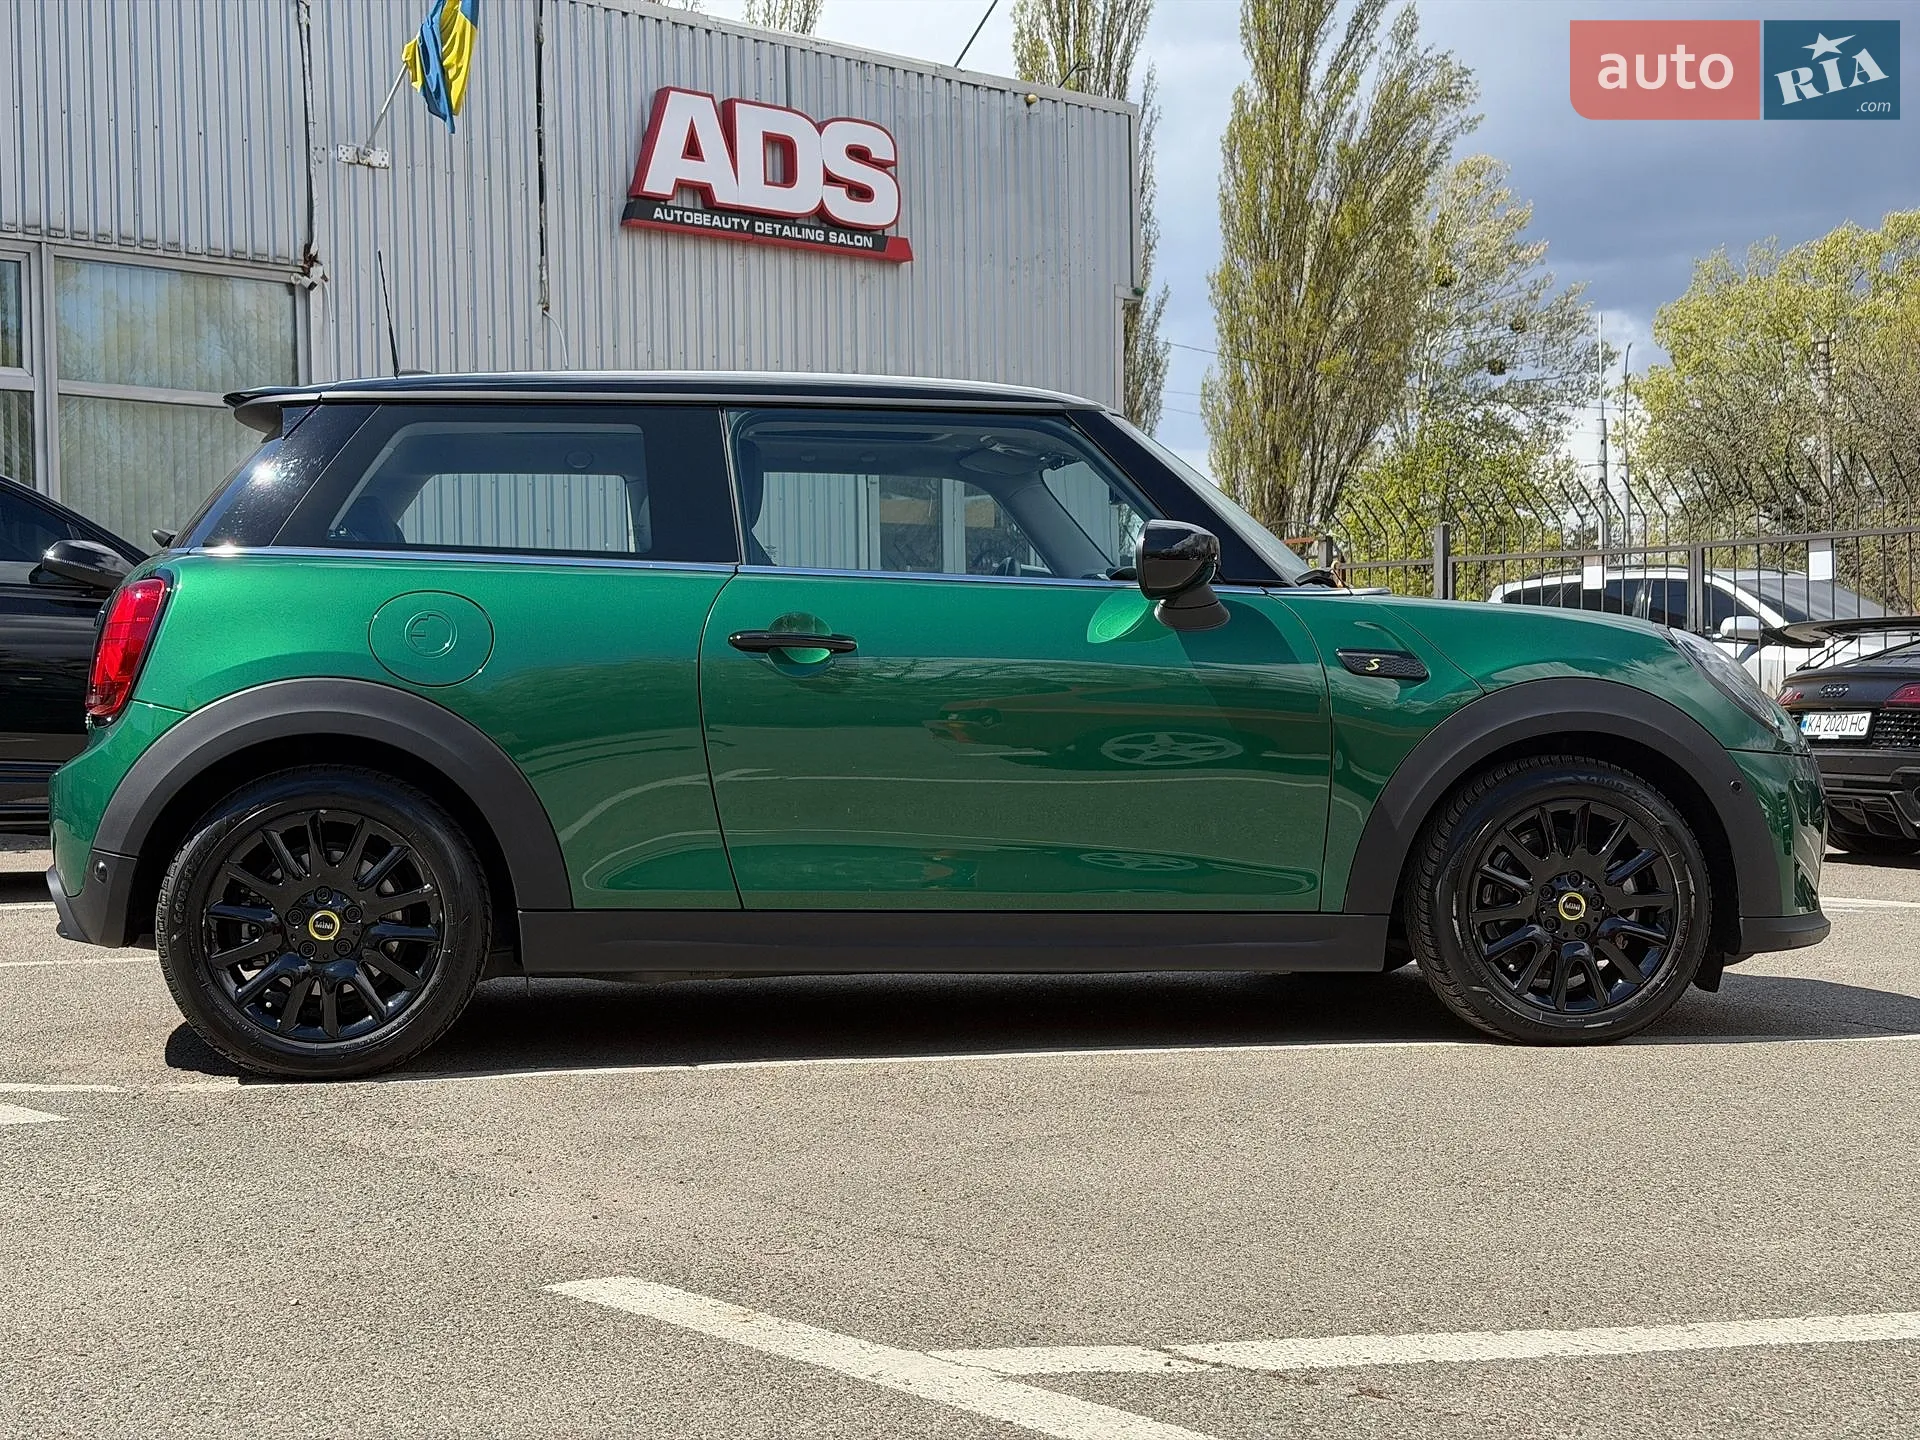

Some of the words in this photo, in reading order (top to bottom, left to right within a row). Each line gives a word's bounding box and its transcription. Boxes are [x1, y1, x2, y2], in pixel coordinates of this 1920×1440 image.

[635, 87, 899, 228] ADS
[653, 207, 750, 231] AUTOBEAUTY
[754, 221, 825, 242] DETAILING
[828, 231, 873, 248] SALON
[1365, 658, 1381, 671] S
[1807, 715, 1821, 732] KA
[1823, 715, 1849, 732] 2020
[1849, 715, 1867, 732] HC
[314, 920, 334, 930] MINI
